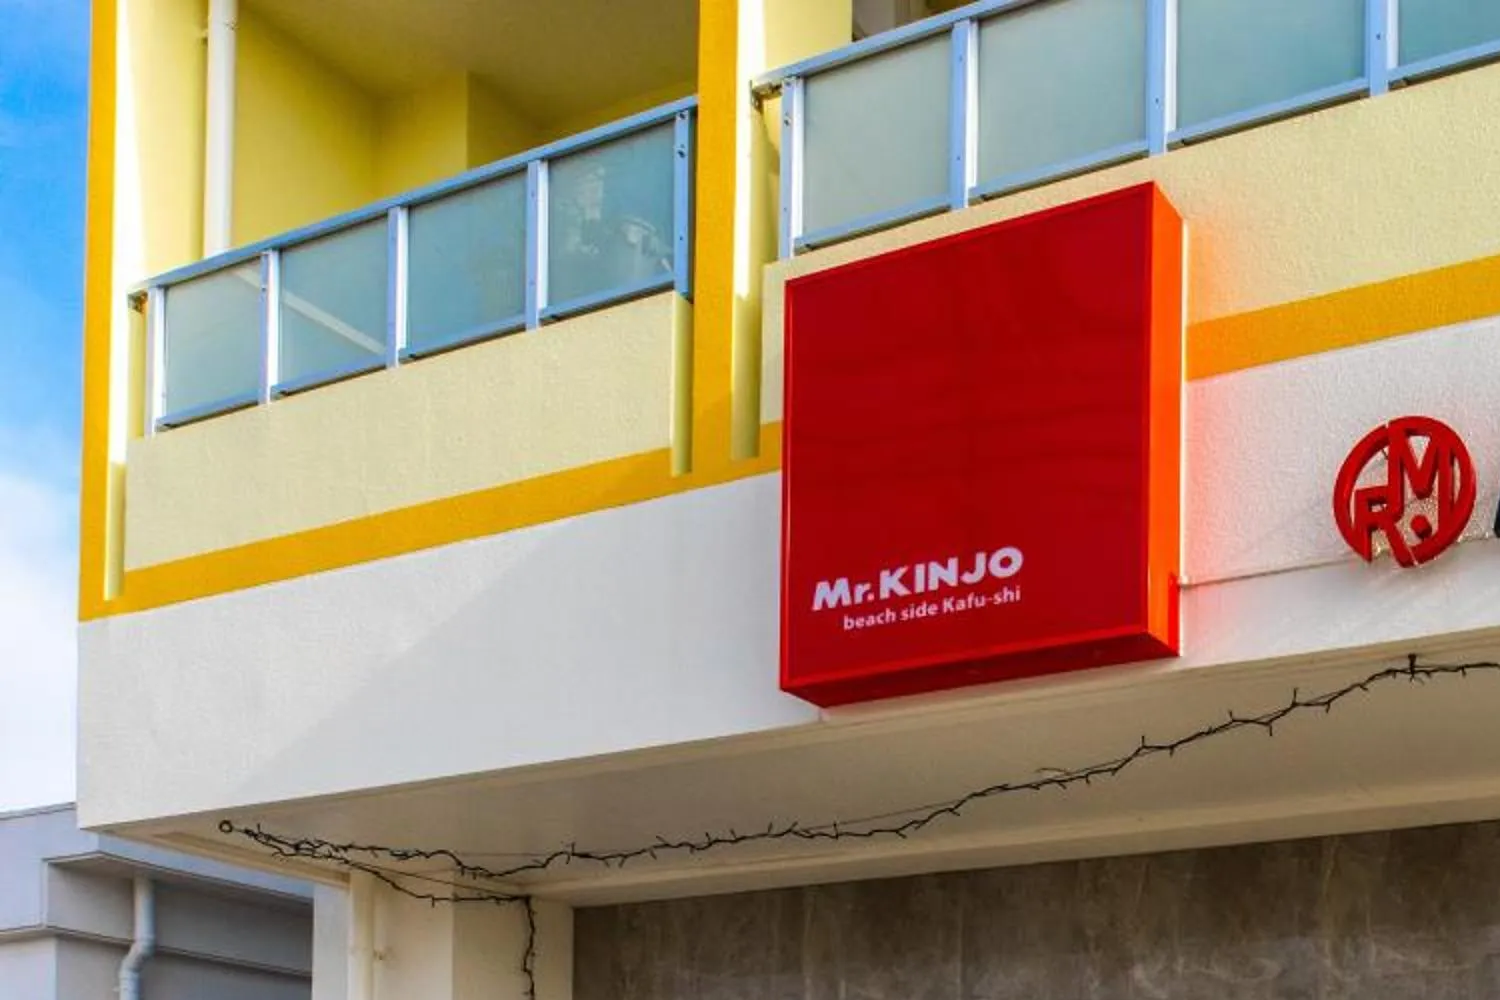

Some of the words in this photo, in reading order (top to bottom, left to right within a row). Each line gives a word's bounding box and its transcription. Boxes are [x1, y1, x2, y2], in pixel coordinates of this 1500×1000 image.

[812, 545, 1024, 611] Mr.KINJO
[843, 607, 897, 630] beach
[901, 602, 939, 622] side
[943, 585, 1022, 614] Kafu-shi
